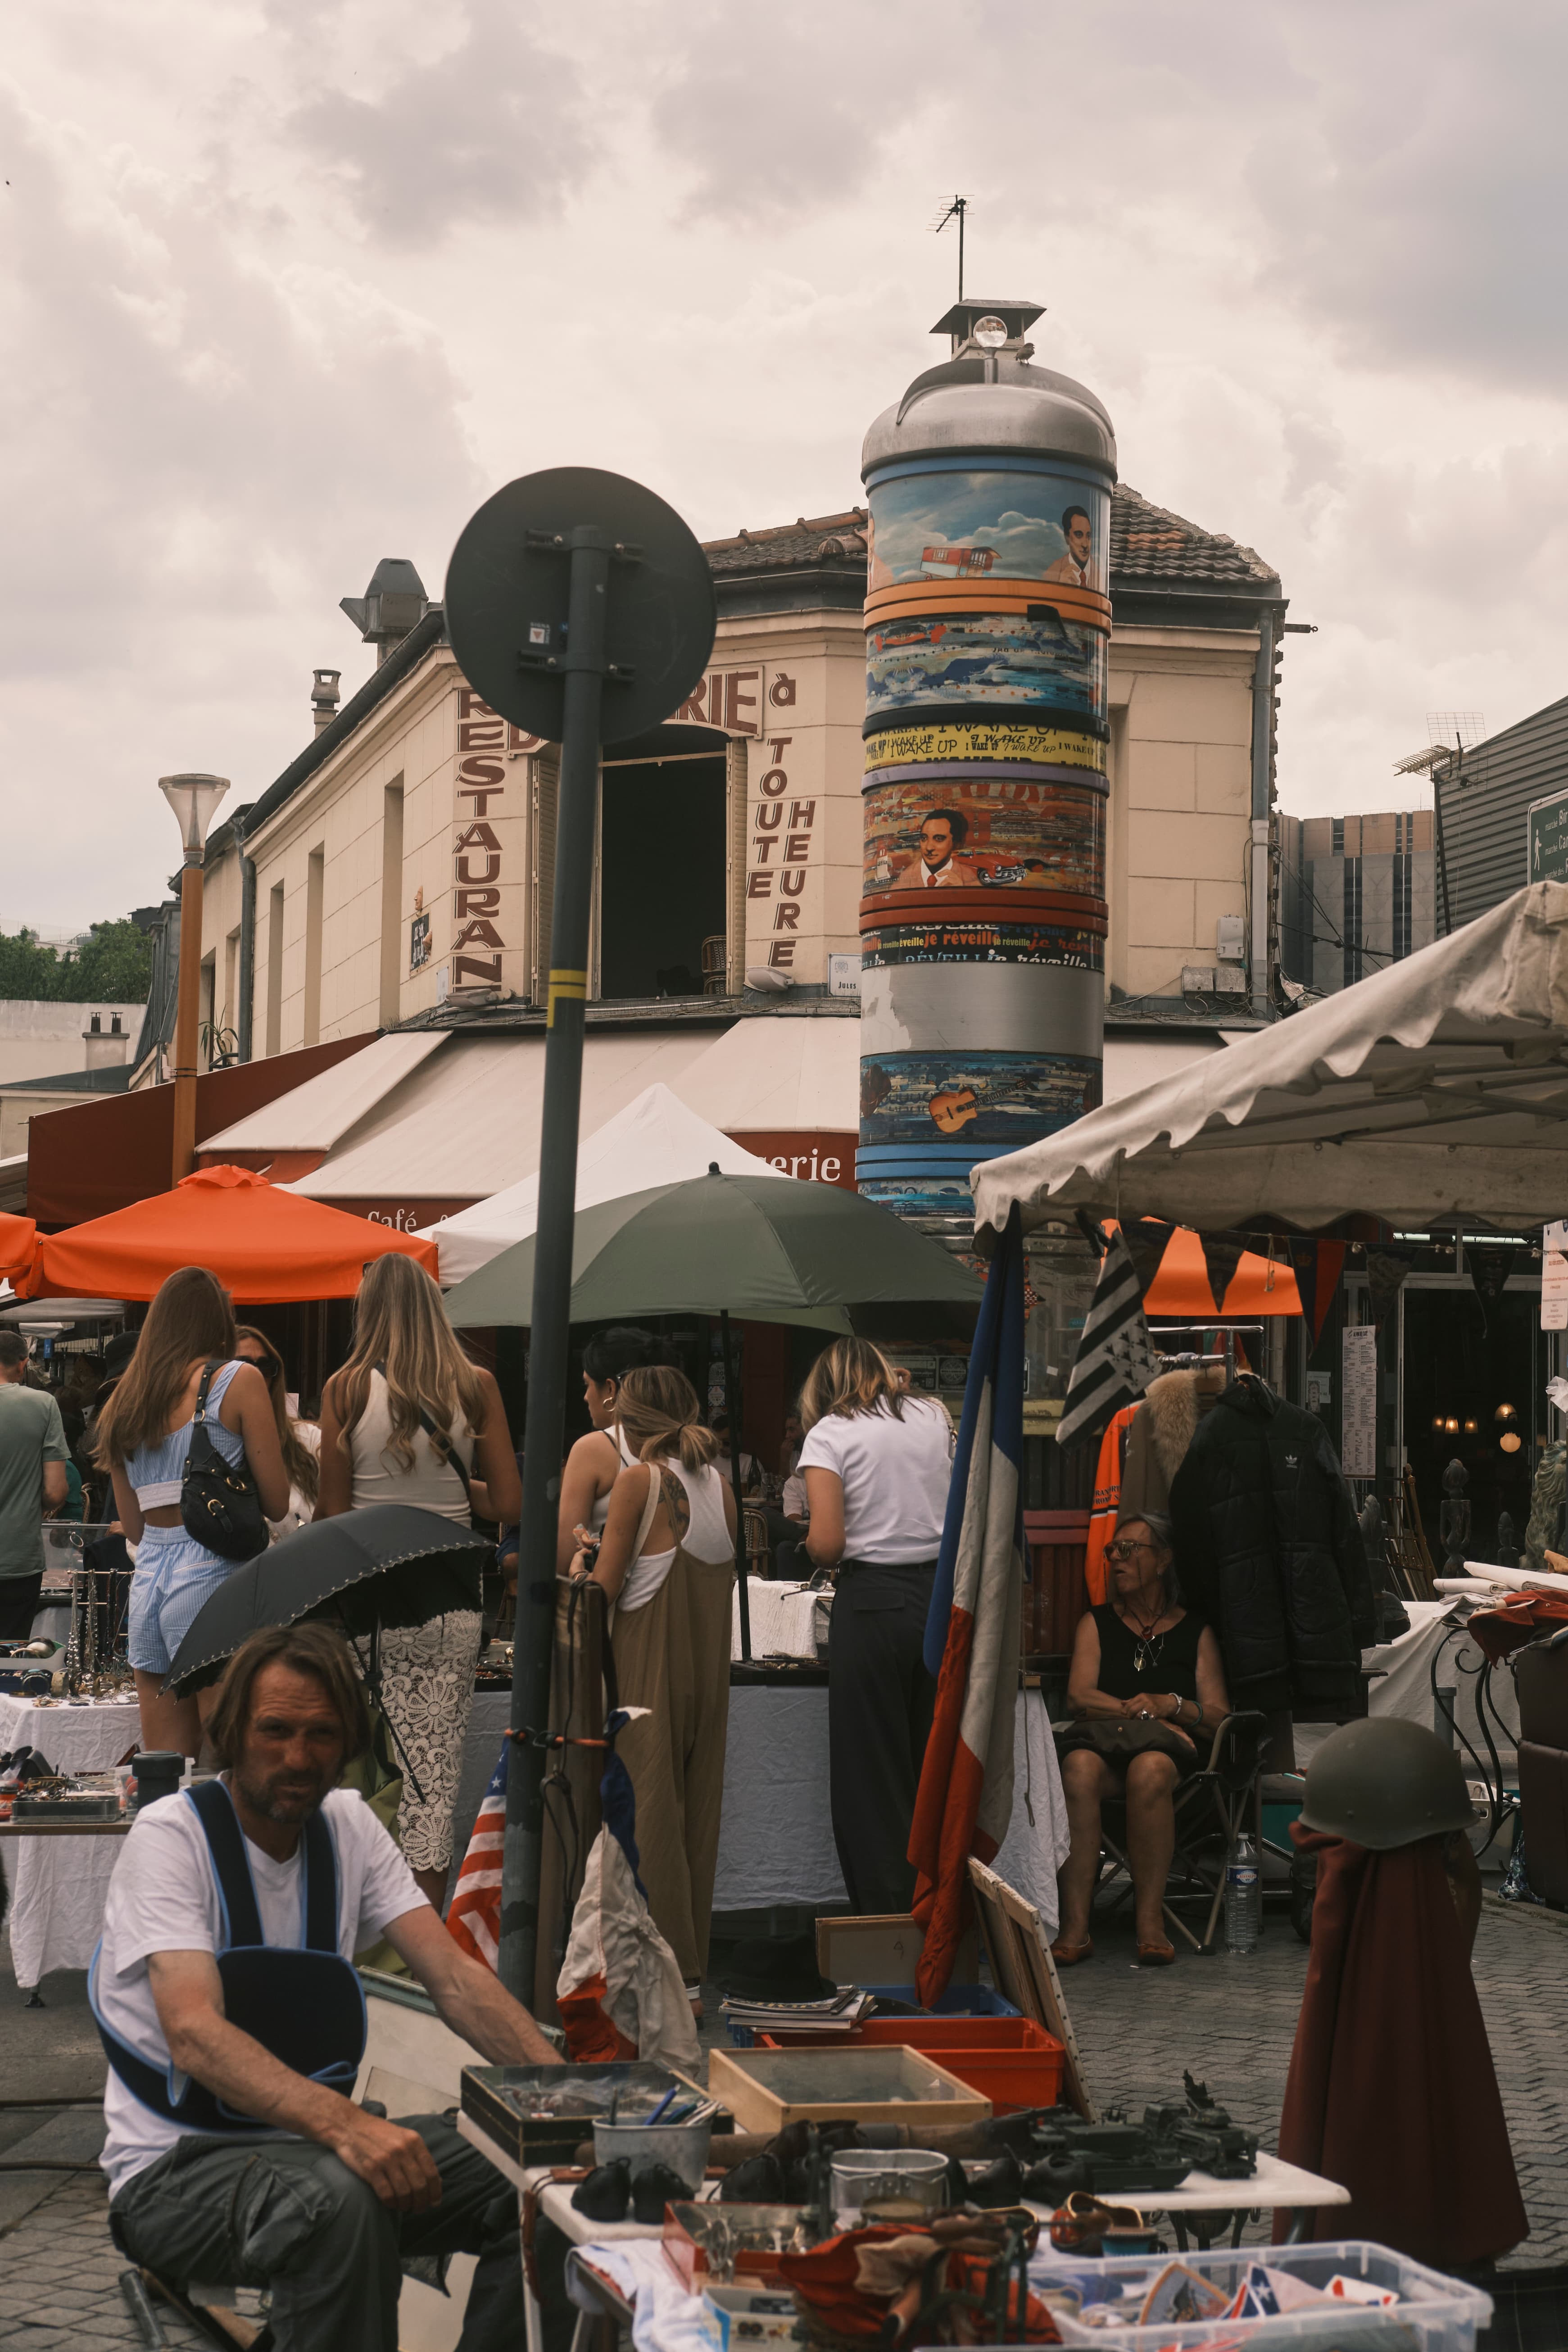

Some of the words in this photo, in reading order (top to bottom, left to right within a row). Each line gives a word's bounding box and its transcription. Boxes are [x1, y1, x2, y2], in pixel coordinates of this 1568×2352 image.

[747, 737, 792, 899] TOUTE
[938, 739, 957, 753] UP
[452, 689, 506, 992] RESTAURAN
[768, 800, 816, 967] HEURE
